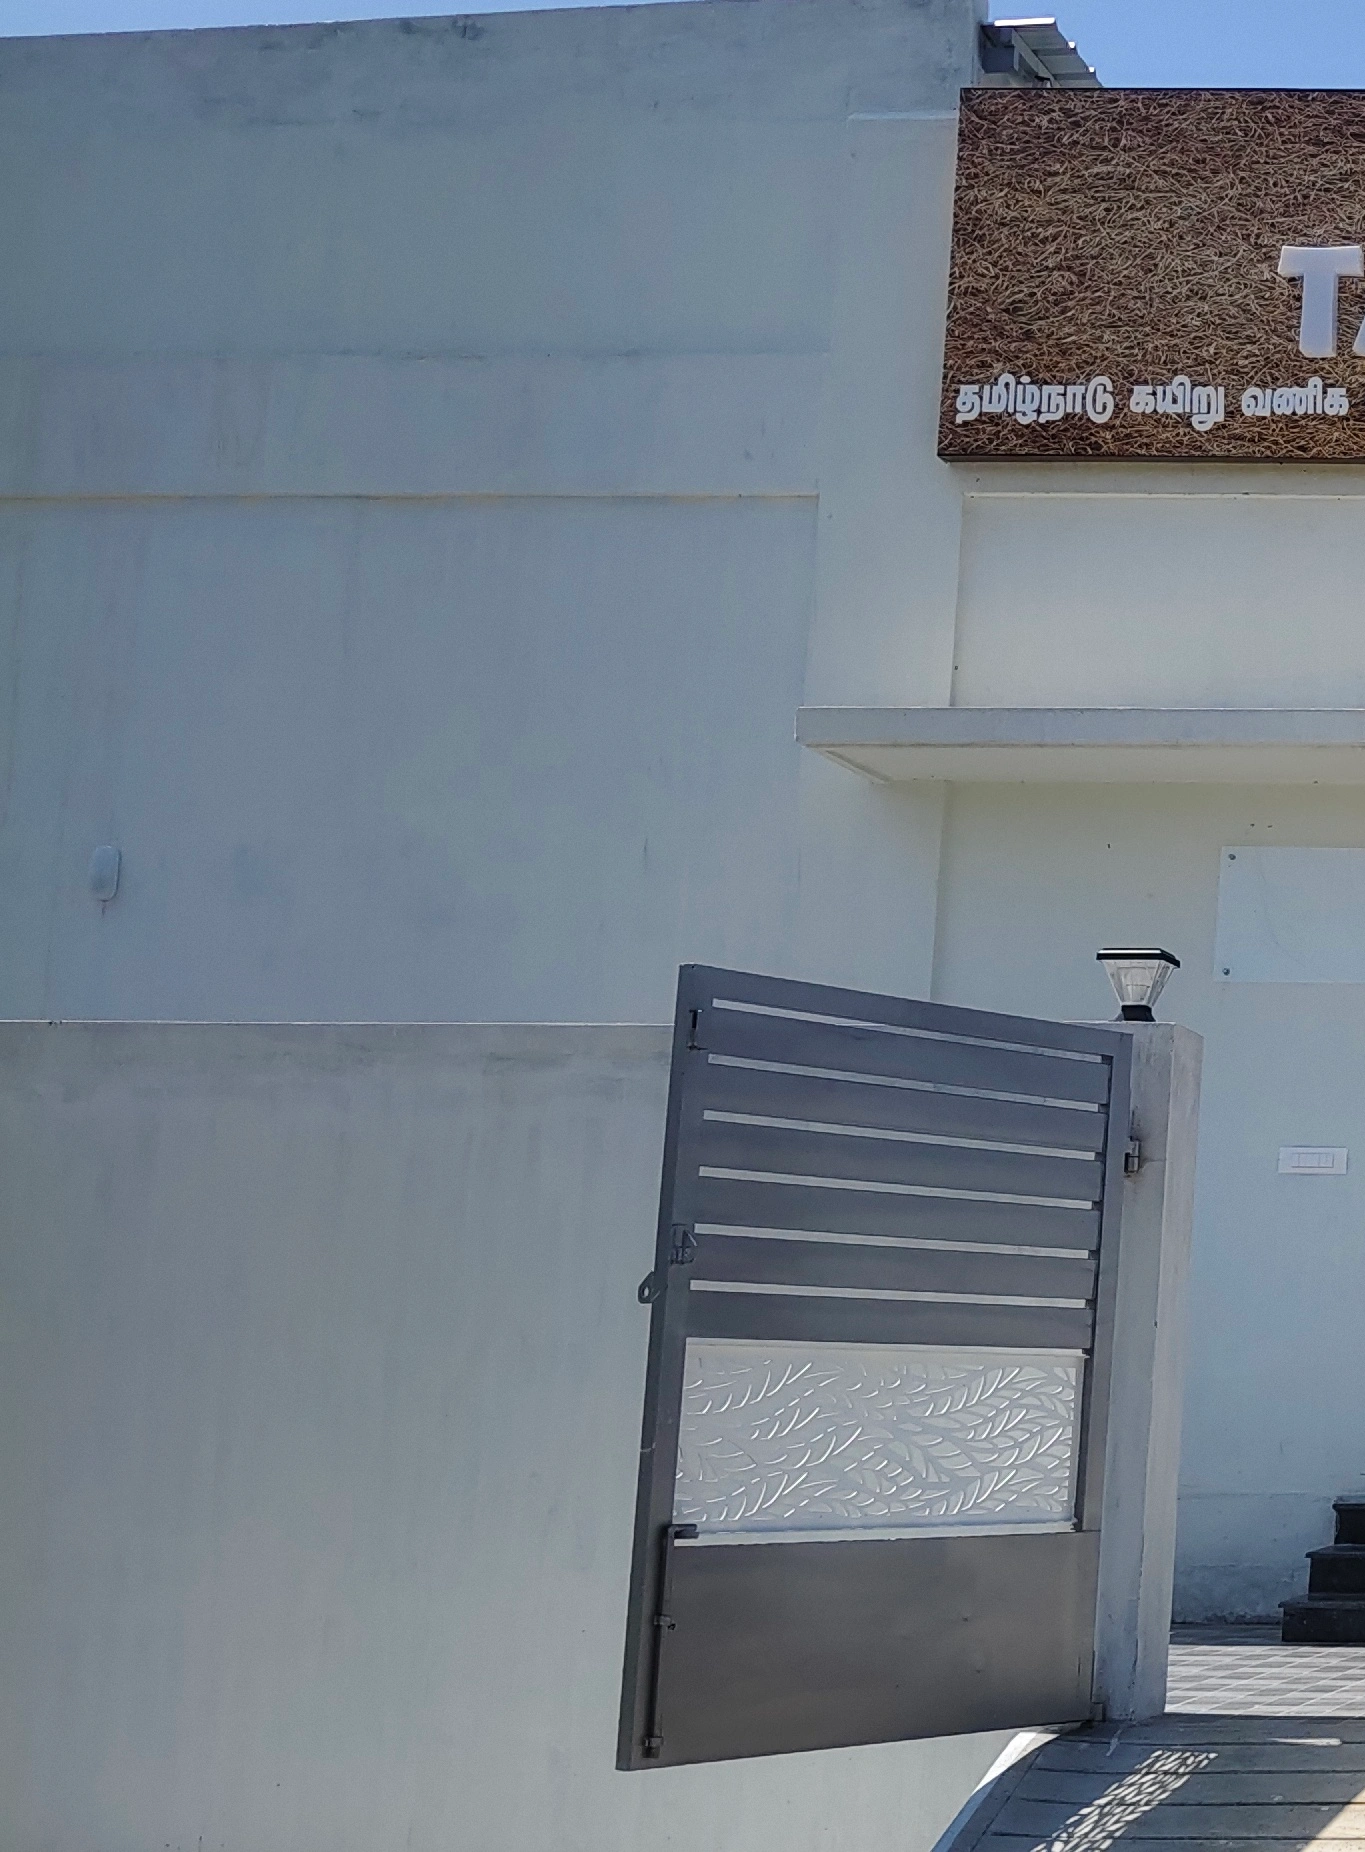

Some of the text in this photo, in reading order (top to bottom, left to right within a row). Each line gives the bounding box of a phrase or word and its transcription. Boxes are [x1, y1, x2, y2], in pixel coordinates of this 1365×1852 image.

[956, 373, 1115, 424] தமிழ்நாடு
[1129, 375, 1225, 431] கயிறு
[1242, 377, 1350, 416] வணிக
